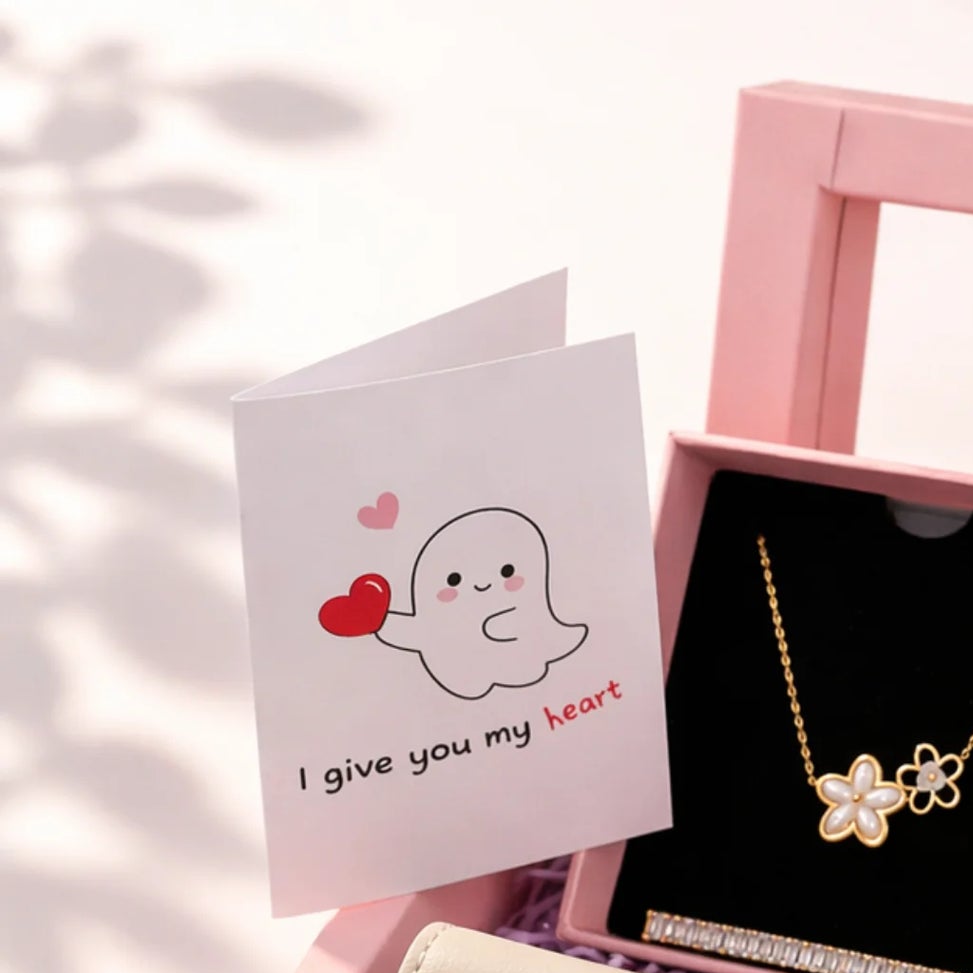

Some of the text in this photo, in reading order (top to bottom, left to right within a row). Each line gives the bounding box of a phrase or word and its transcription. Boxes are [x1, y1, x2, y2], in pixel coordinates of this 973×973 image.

[299, 680, 623, 795] I give you my heart
